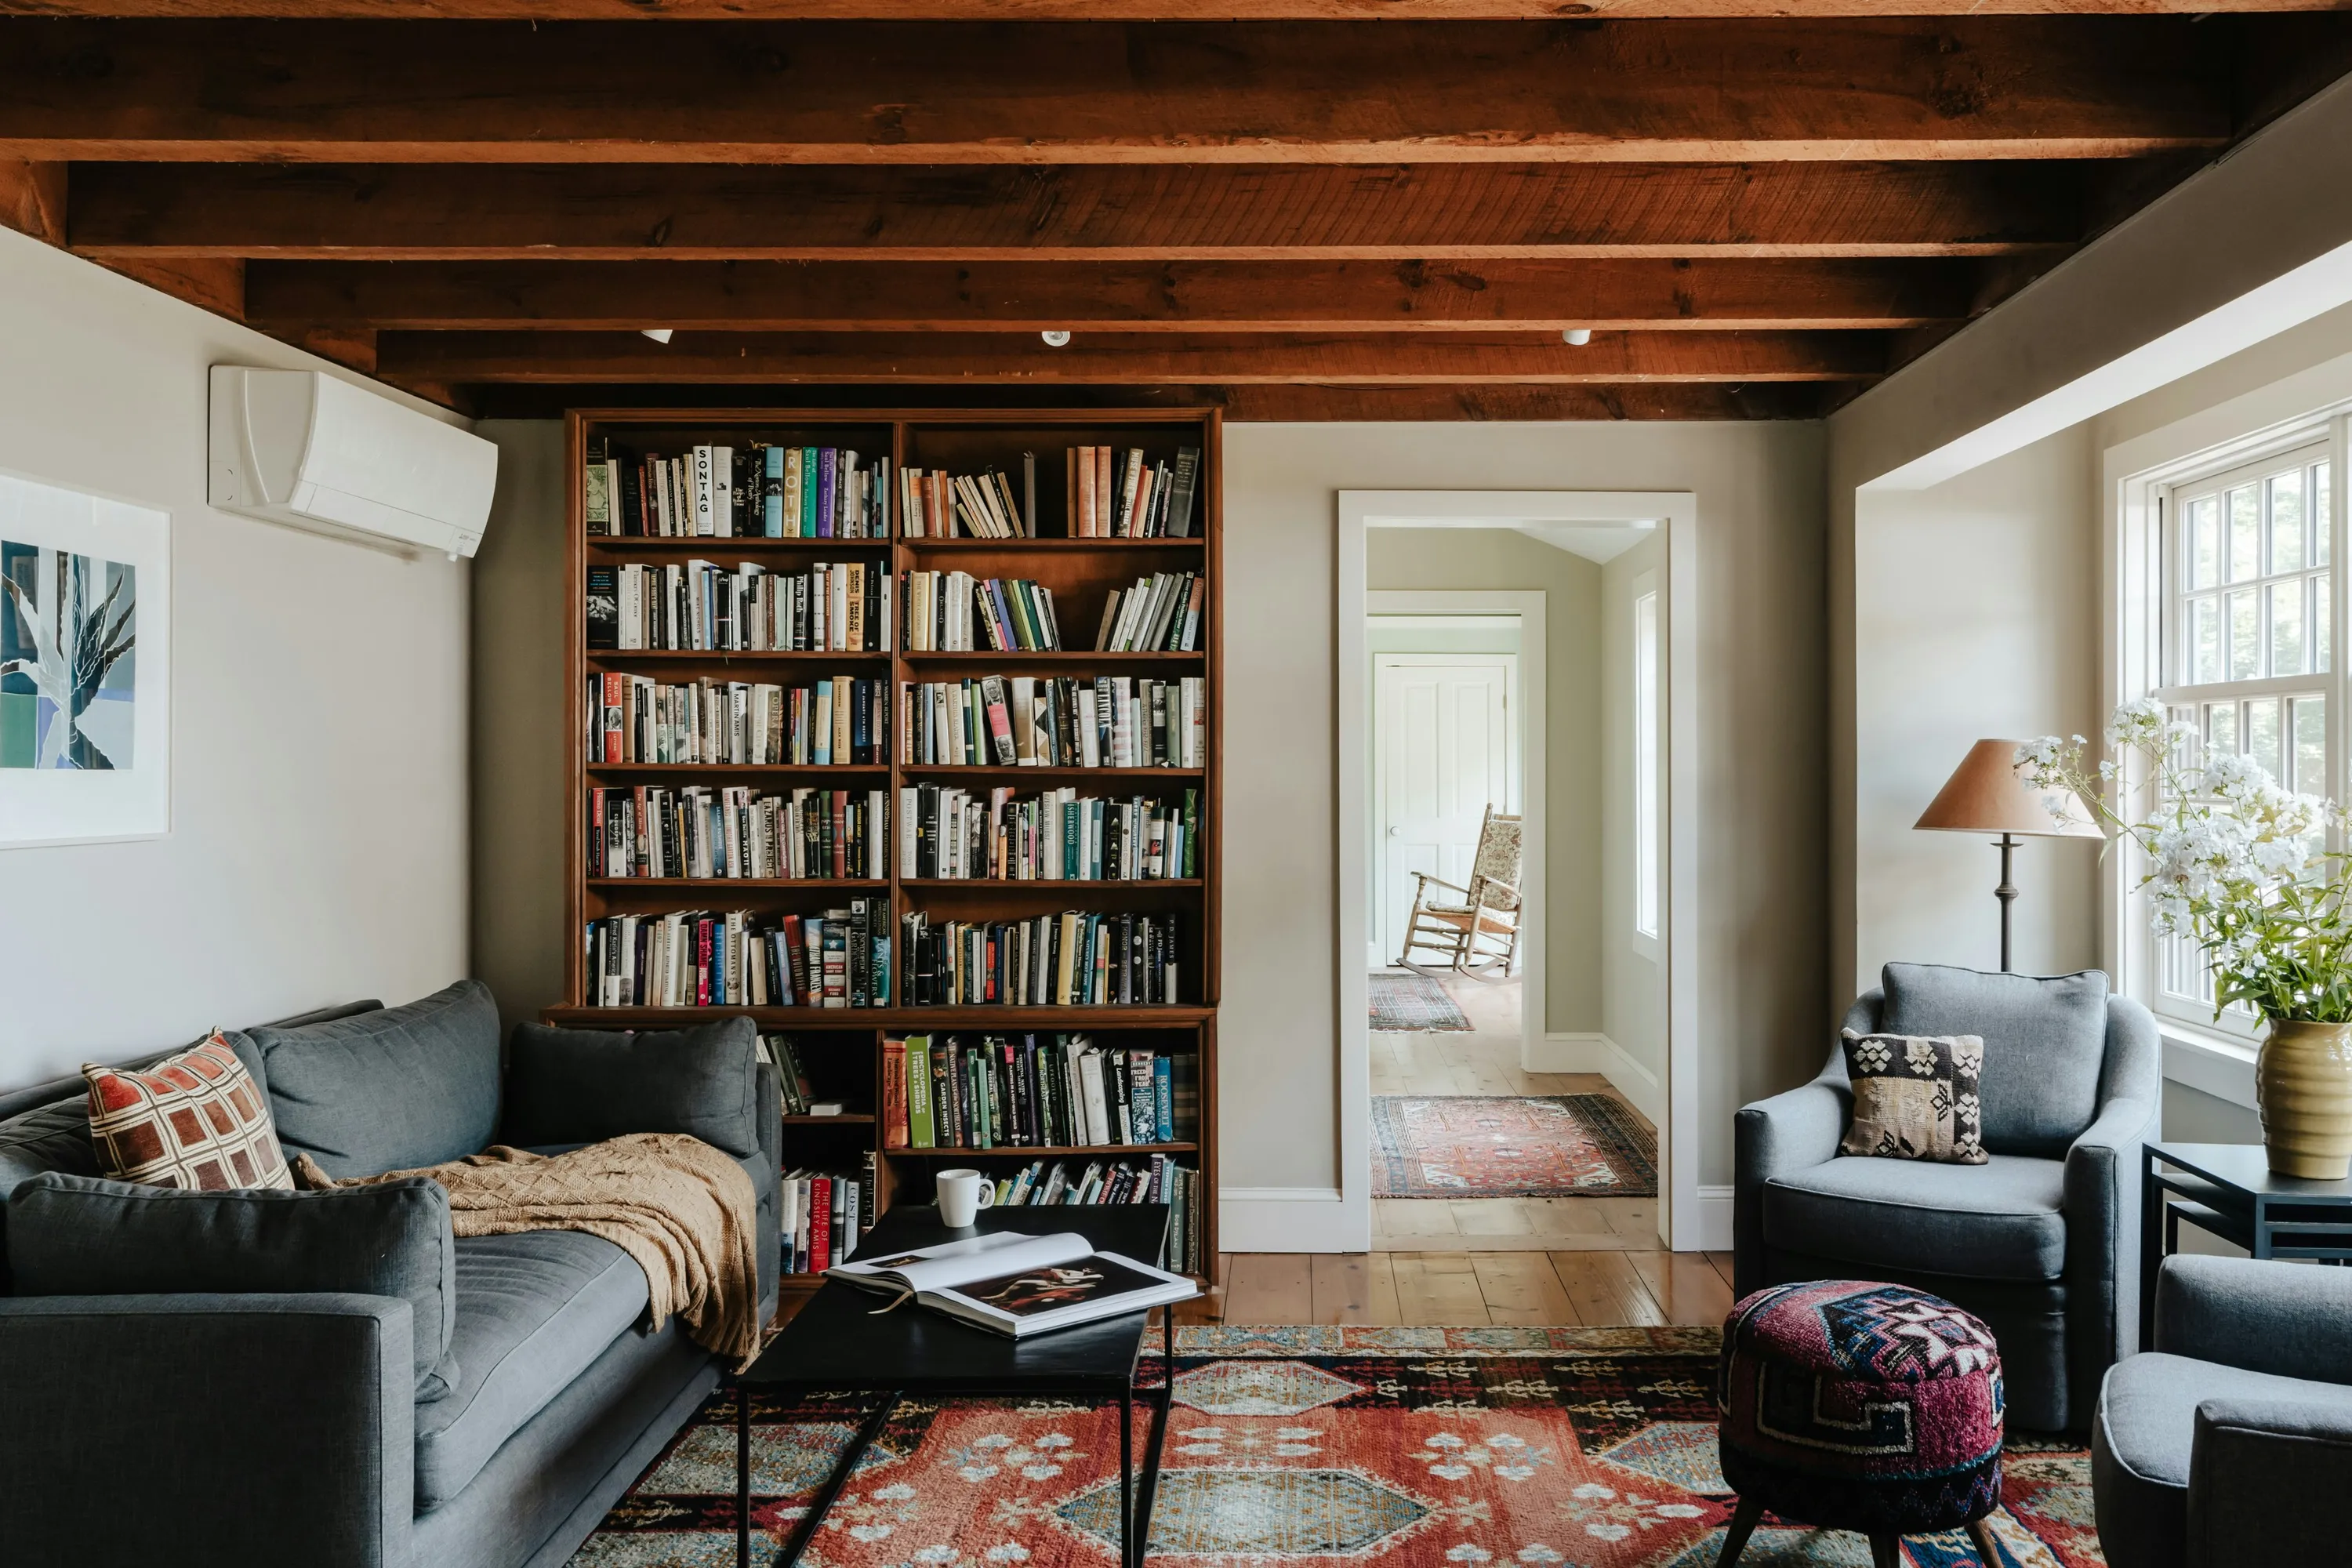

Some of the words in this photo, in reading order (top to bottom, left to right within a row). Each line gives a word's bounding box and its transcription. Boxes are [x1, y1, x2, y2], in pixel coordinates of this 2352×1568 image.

[1130, 452, 1139, 470] MUSE
[699, 450, 708, 513] SONTAG
[753, 467, 762, 488] Norton
[786, 456, 797, 527] ROTH
[795, 576, 804, 596] Philip
[1192, 582, 1203, 603] Opera
[854, 622, 859, 632] OF
[764, 801, 773, 833] LAZARUS
[765, 841, 774, 869] PROJECT
[790, 945, 800, 956] THE
[809, 932, 821, 964] ATHAN
[851, 932, 860, 974] GARDENING
[793, 958, 804, 991] VOLUNTEER
[810, 966, 822, 994] FRANZEN
[1048, 1063, 1057, 1101] UPROOTED
[1116, 1068, 1126, 1103] Landscaping
[1160, 1075, 1170, 1127] ROOSEVELT
[821, 1230, 828, 1242] OF
